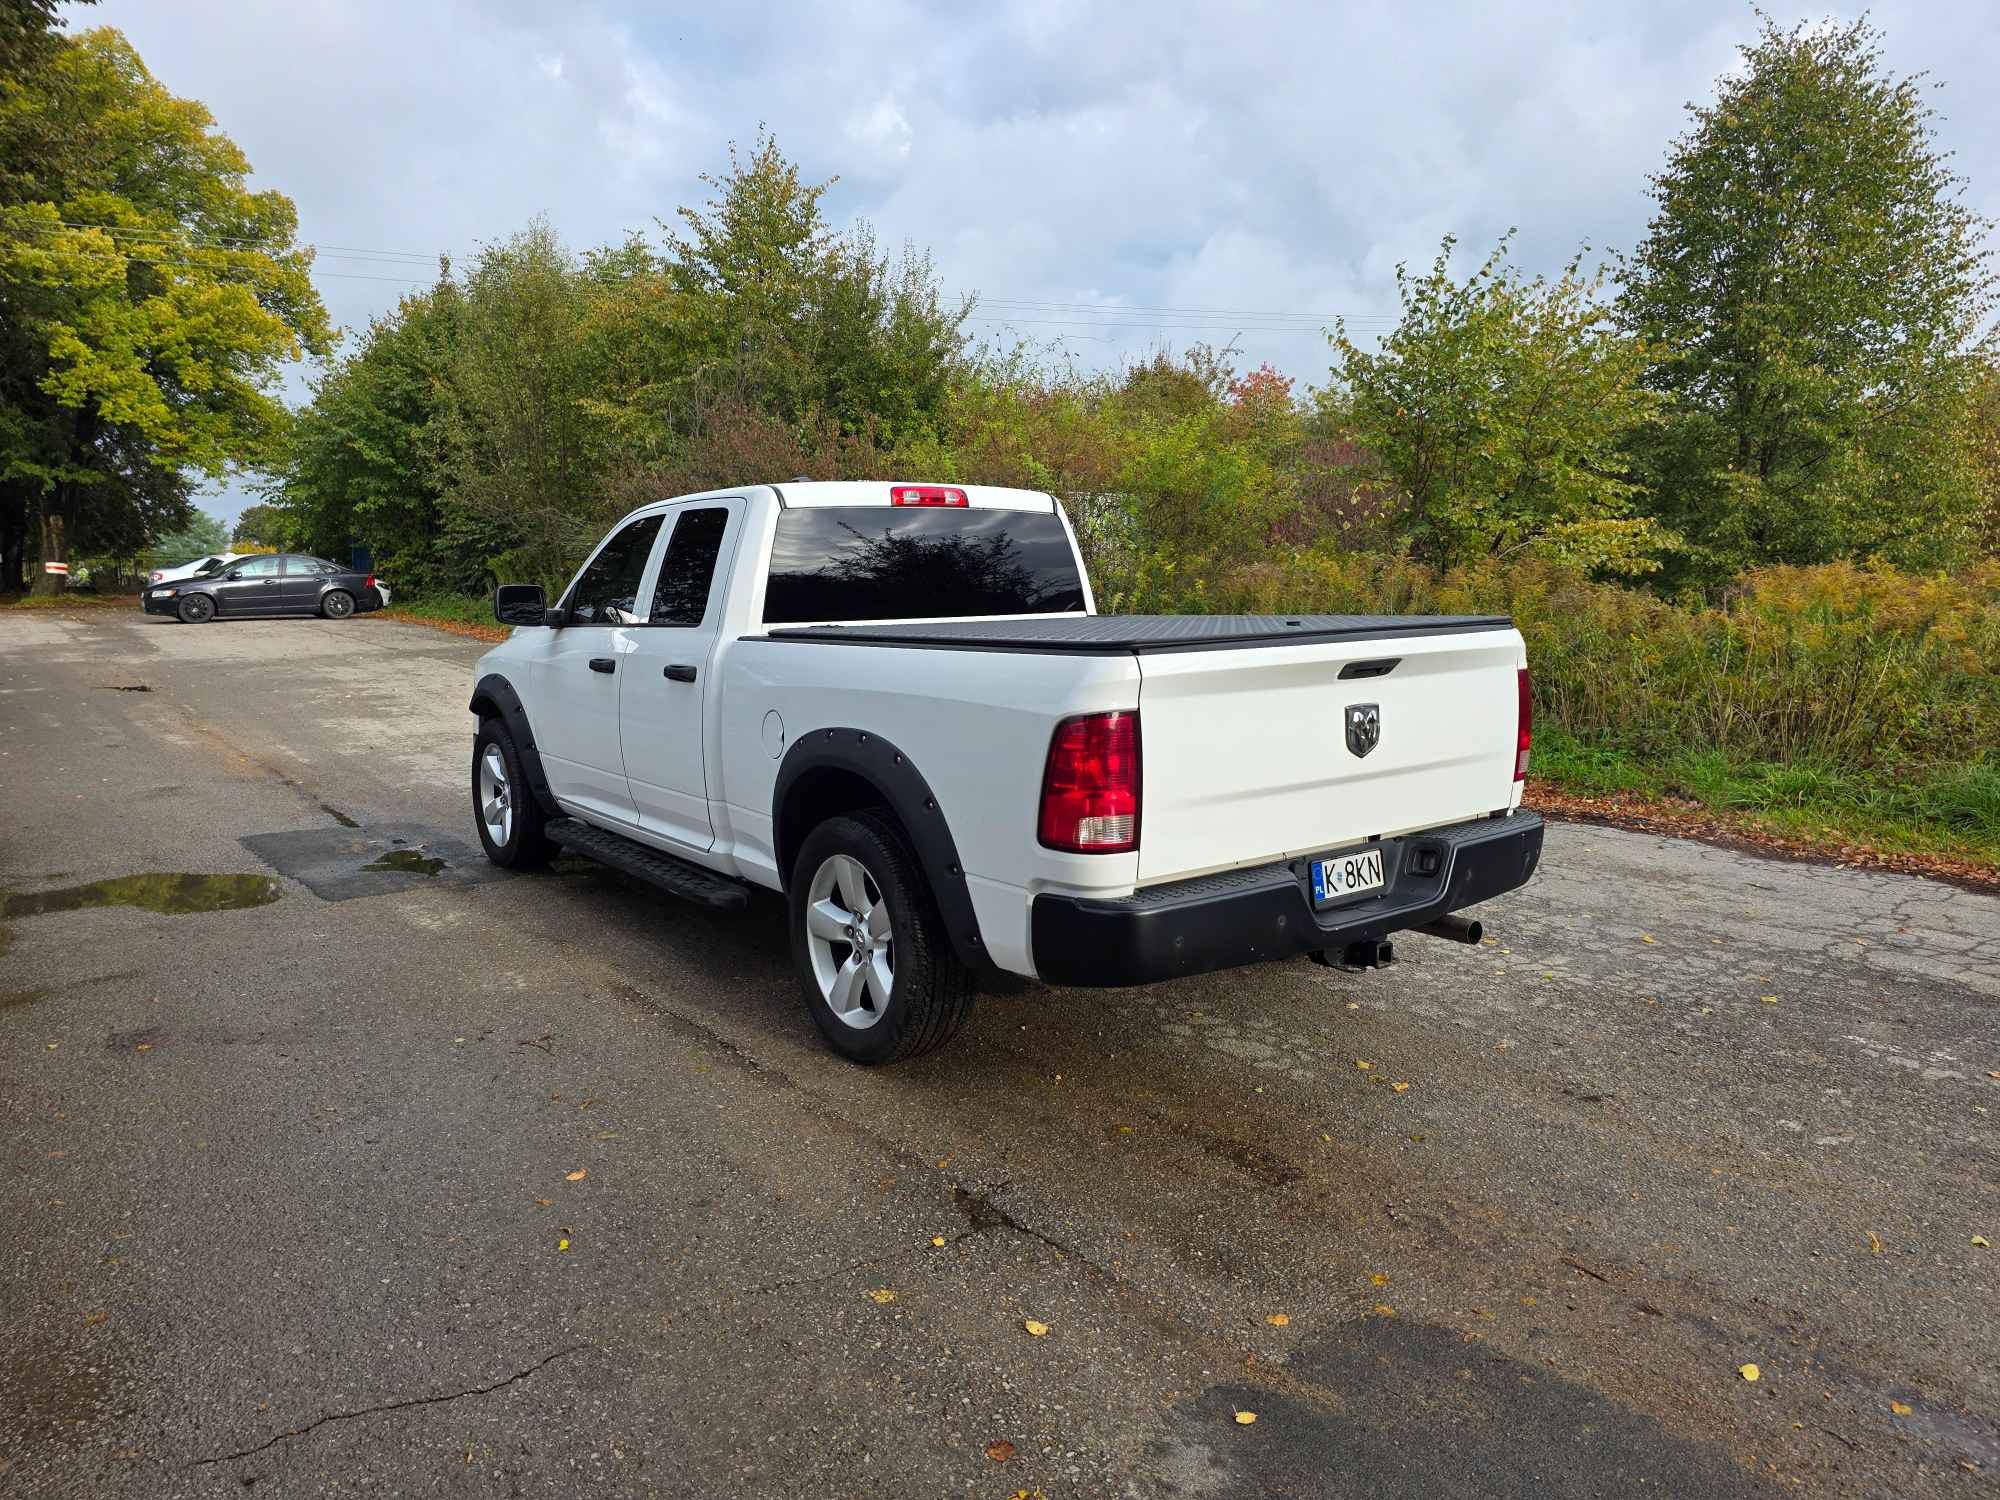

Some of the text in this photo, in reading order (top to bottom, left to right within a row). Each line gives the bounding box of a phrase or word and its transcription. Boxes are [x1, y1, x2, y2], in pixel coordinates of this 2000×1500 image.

[1325, 855, 1381, 893] K 8KN
[1315, 886, 1324, 894] PL
